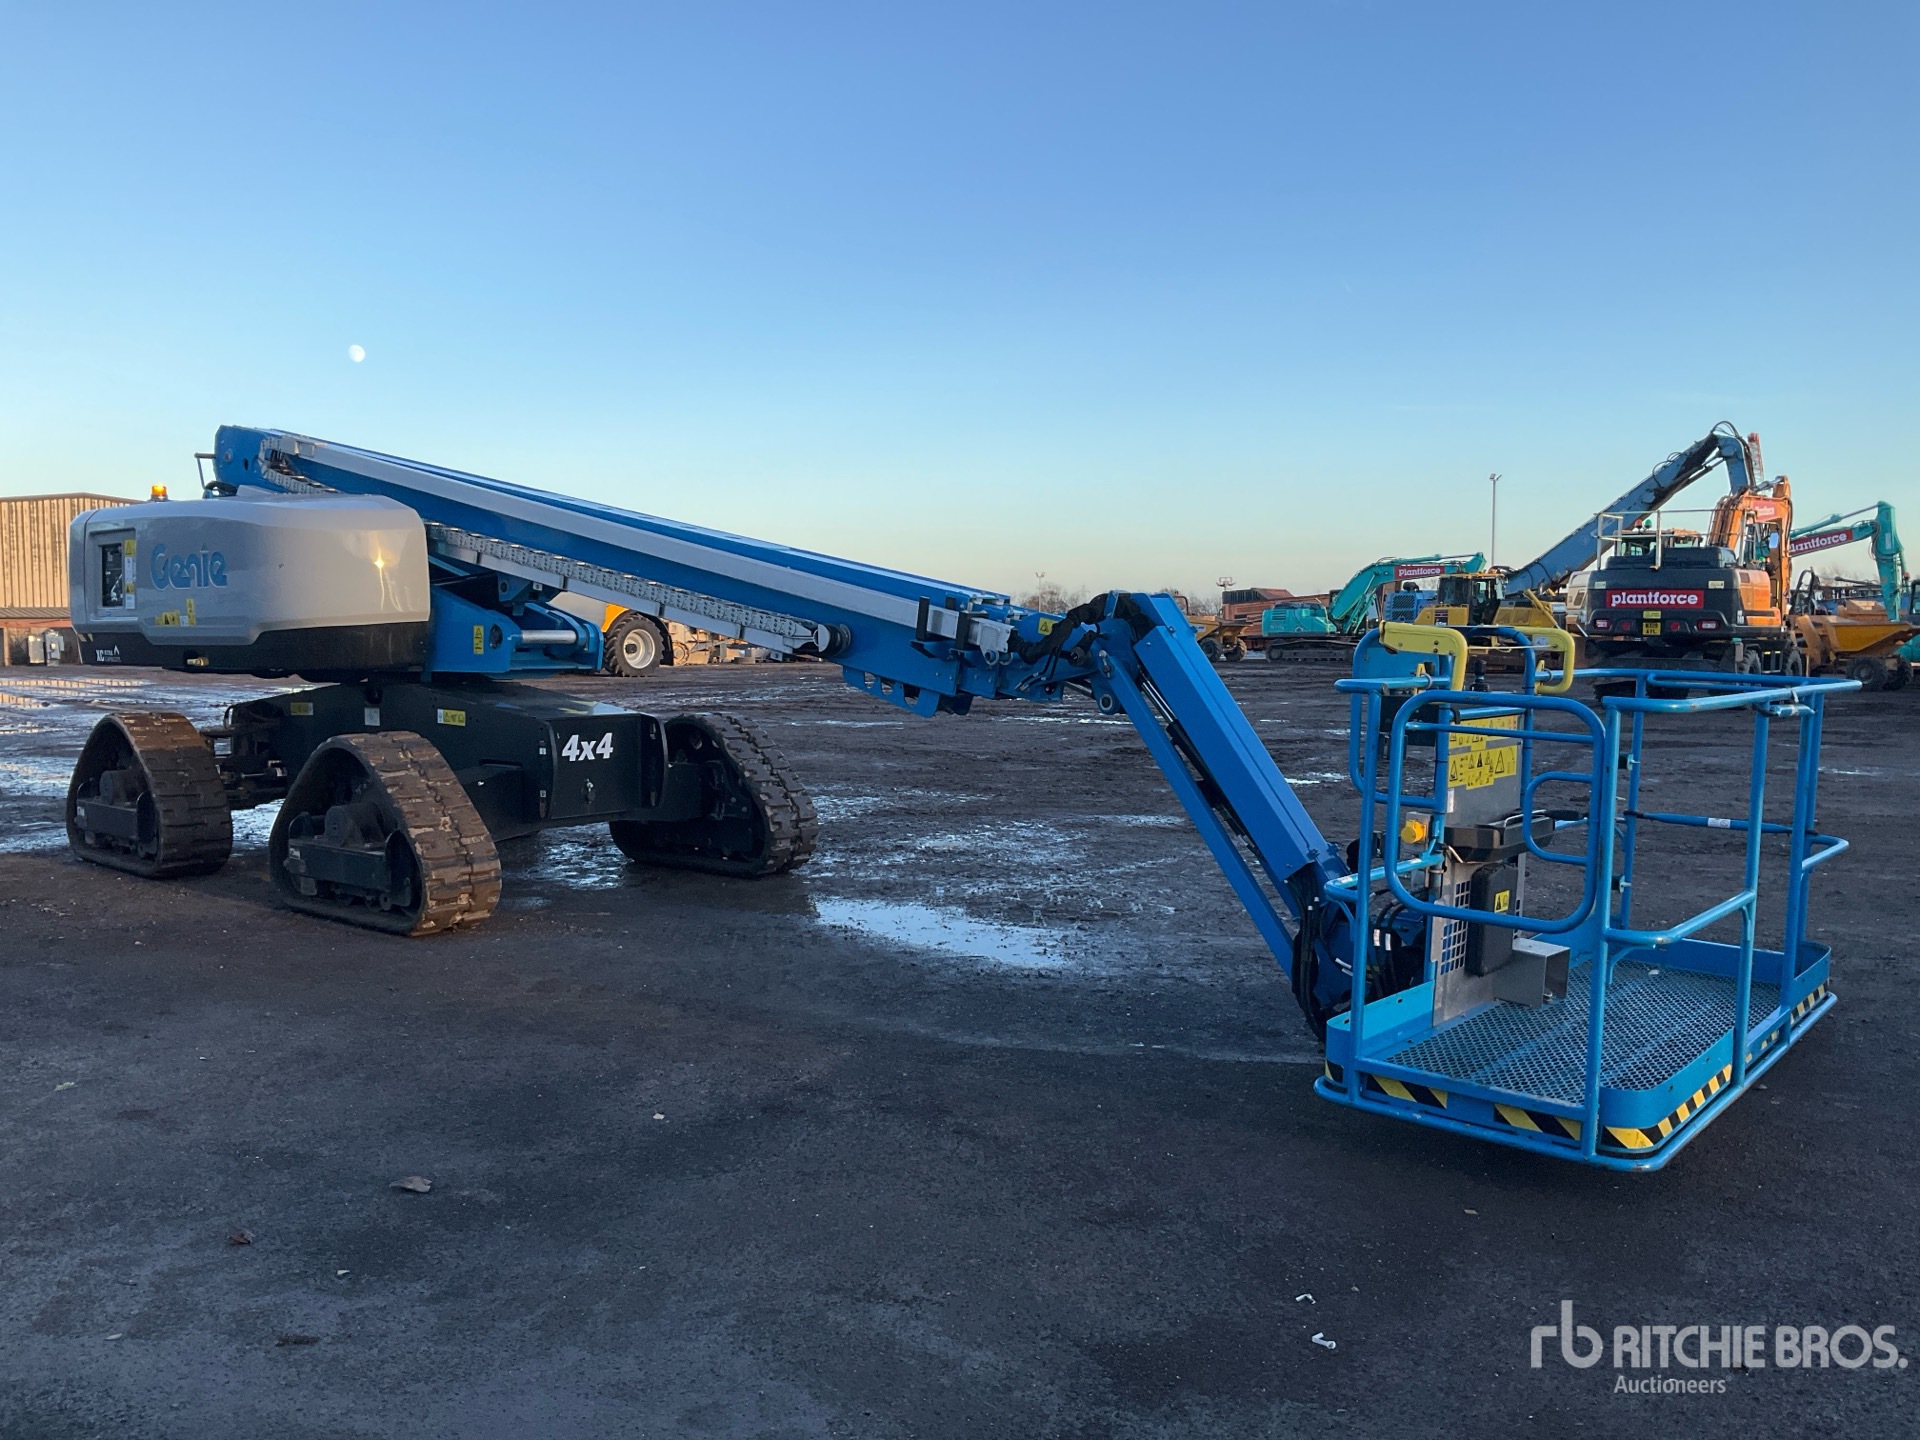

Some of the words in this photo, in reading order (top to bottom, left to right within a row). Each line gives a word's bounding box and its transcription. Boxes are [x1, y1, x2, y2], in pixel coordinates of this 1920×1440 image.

[150, 543, 228, 591] Genie
[1611, 590, 1698, 607] plantforce
[561, 732, 614, 762] 4x4
